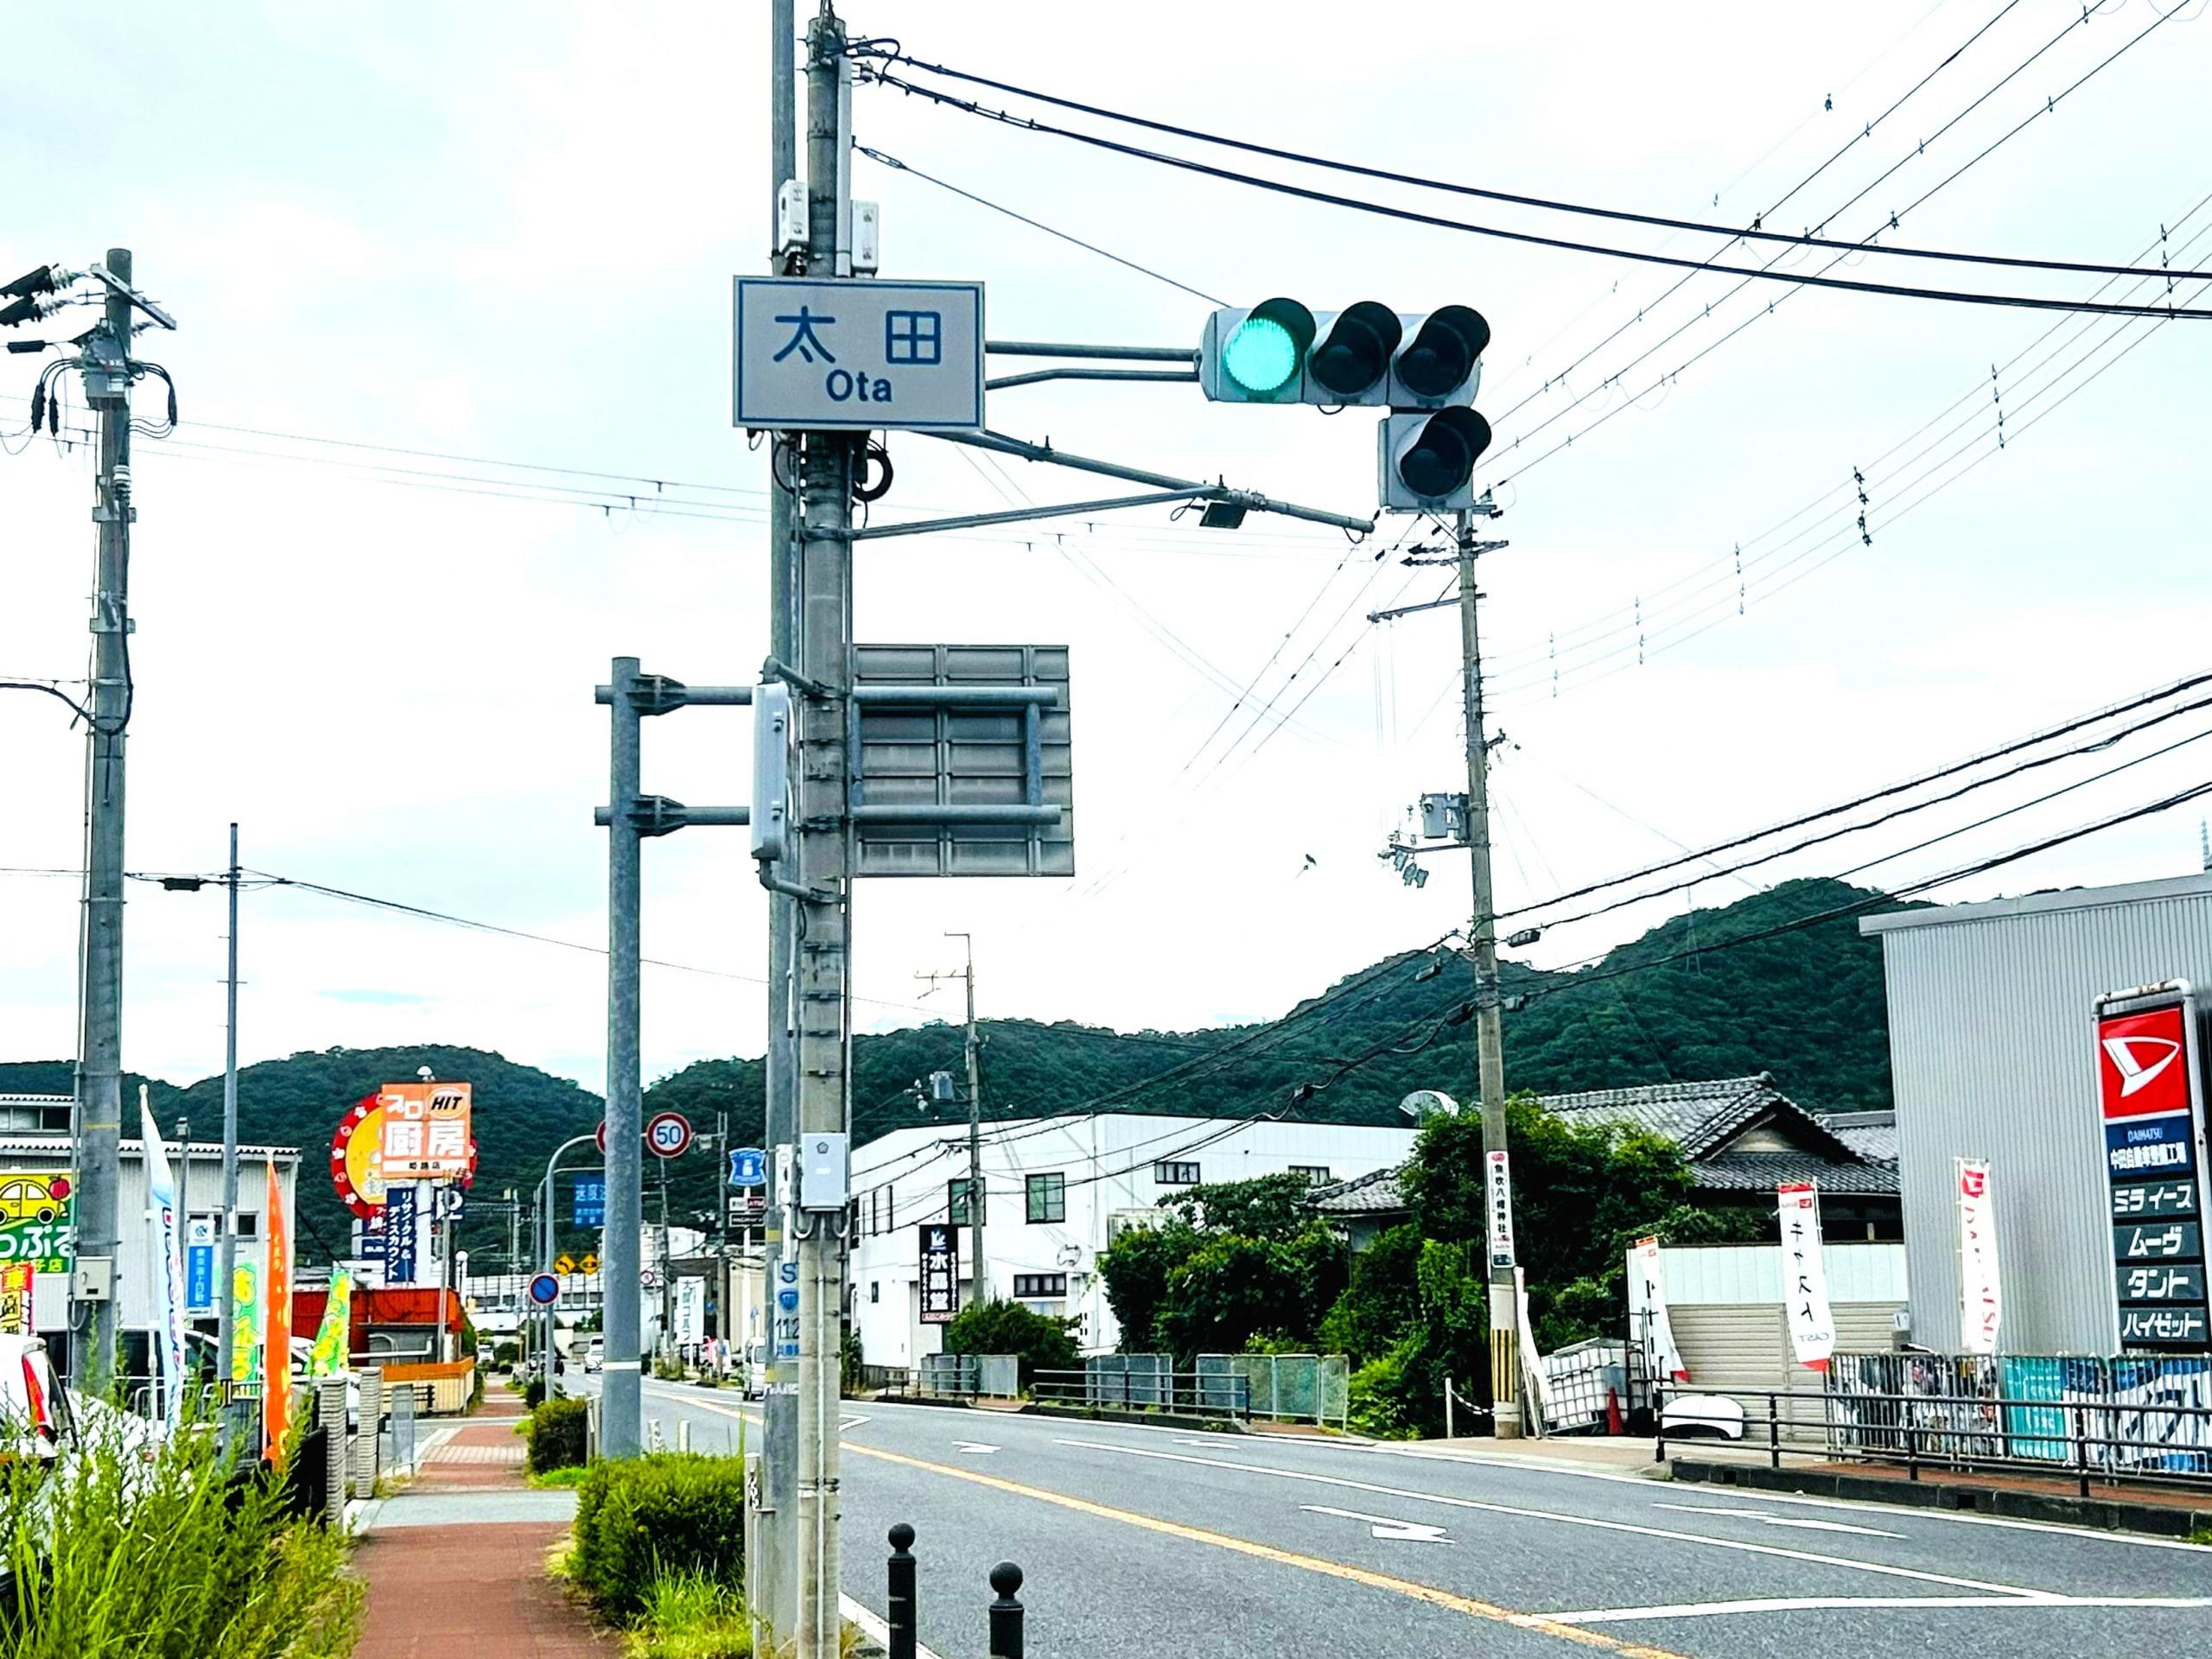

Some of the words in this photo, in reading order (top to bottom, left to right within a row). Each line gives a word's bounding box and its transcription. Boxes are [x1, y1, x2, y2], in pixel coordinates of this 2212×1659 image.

[772, 305, 941, 365] 太田
[826, 369, 893, 402] Ota
[385, 1094, 423, 1120] プロ
[430, 1096, 463, 1111] HIT
[385, 1120, 465, 1157] 厨房
[656, 1125, 681, 1146] 50
[2127, 1226, 2183, 1256] ムーヴ
[2127, 1268, 2190, 1298] タント
[2123, 1312, 2202, 1338] ハイゼット
